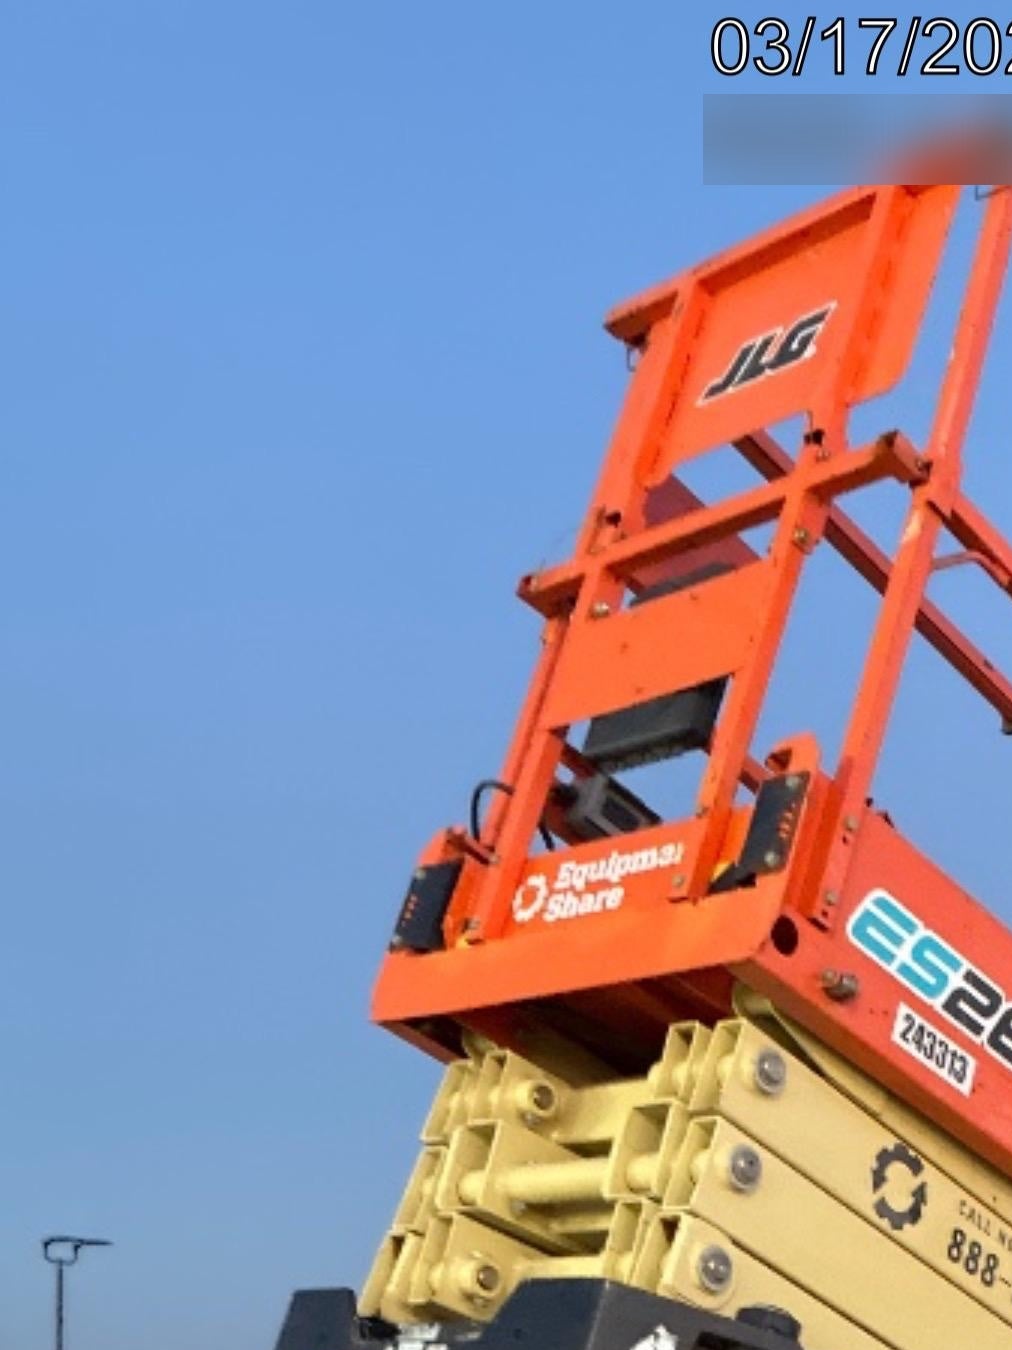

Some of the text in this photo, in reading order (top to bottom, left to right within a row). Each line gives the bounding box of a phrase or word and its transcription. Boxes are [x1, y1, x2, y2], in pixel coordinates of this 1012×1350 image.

[698, 302, 836, 404] JLG
[542, 886, 625, 922] Share
[898, 1012, 970, 1085] 243313
[958, 1199, 992, 1237] CALL
